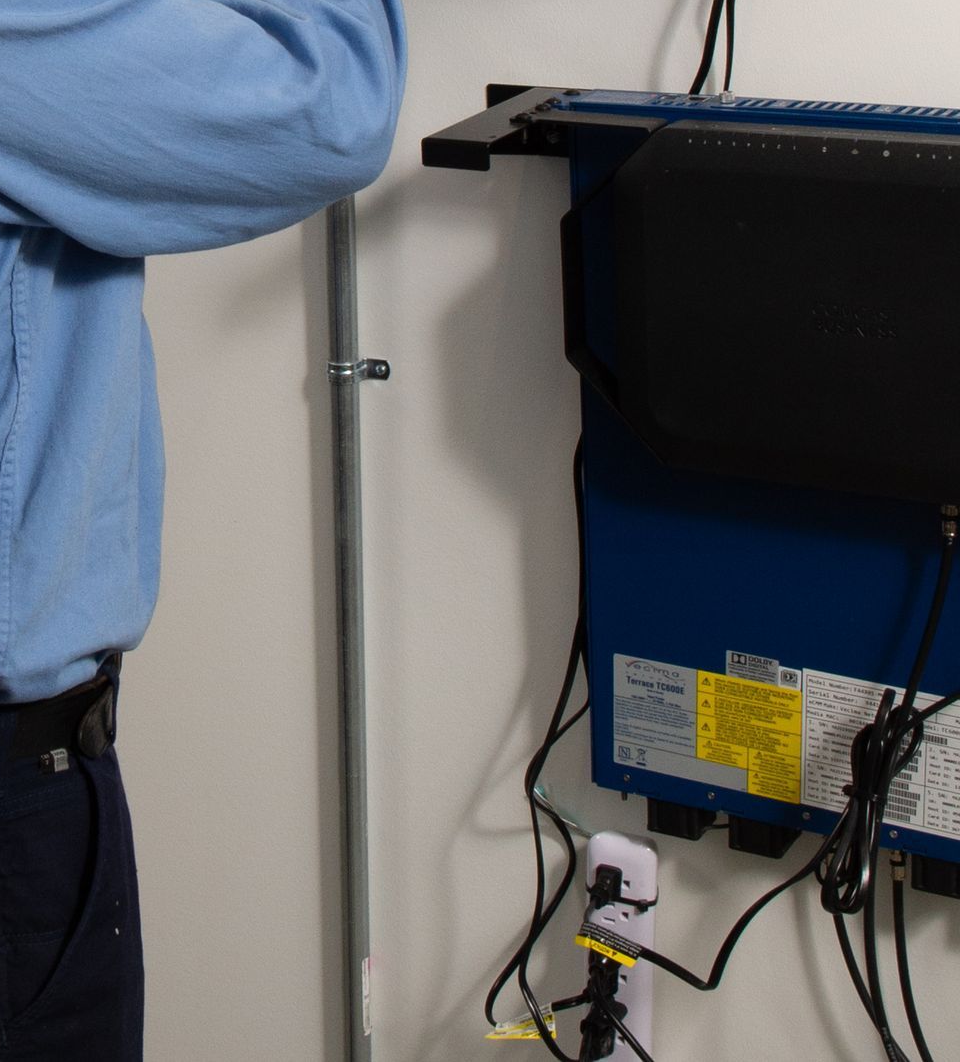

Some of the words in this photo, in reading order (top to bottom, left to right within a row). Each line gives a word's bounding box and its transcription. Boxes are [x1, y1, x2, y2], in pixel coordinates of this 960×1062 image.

[748, 655, 773, 666] DOLBY
[626, 676, 654, 689] Terrace
[808, 678, 826, 687] Model
